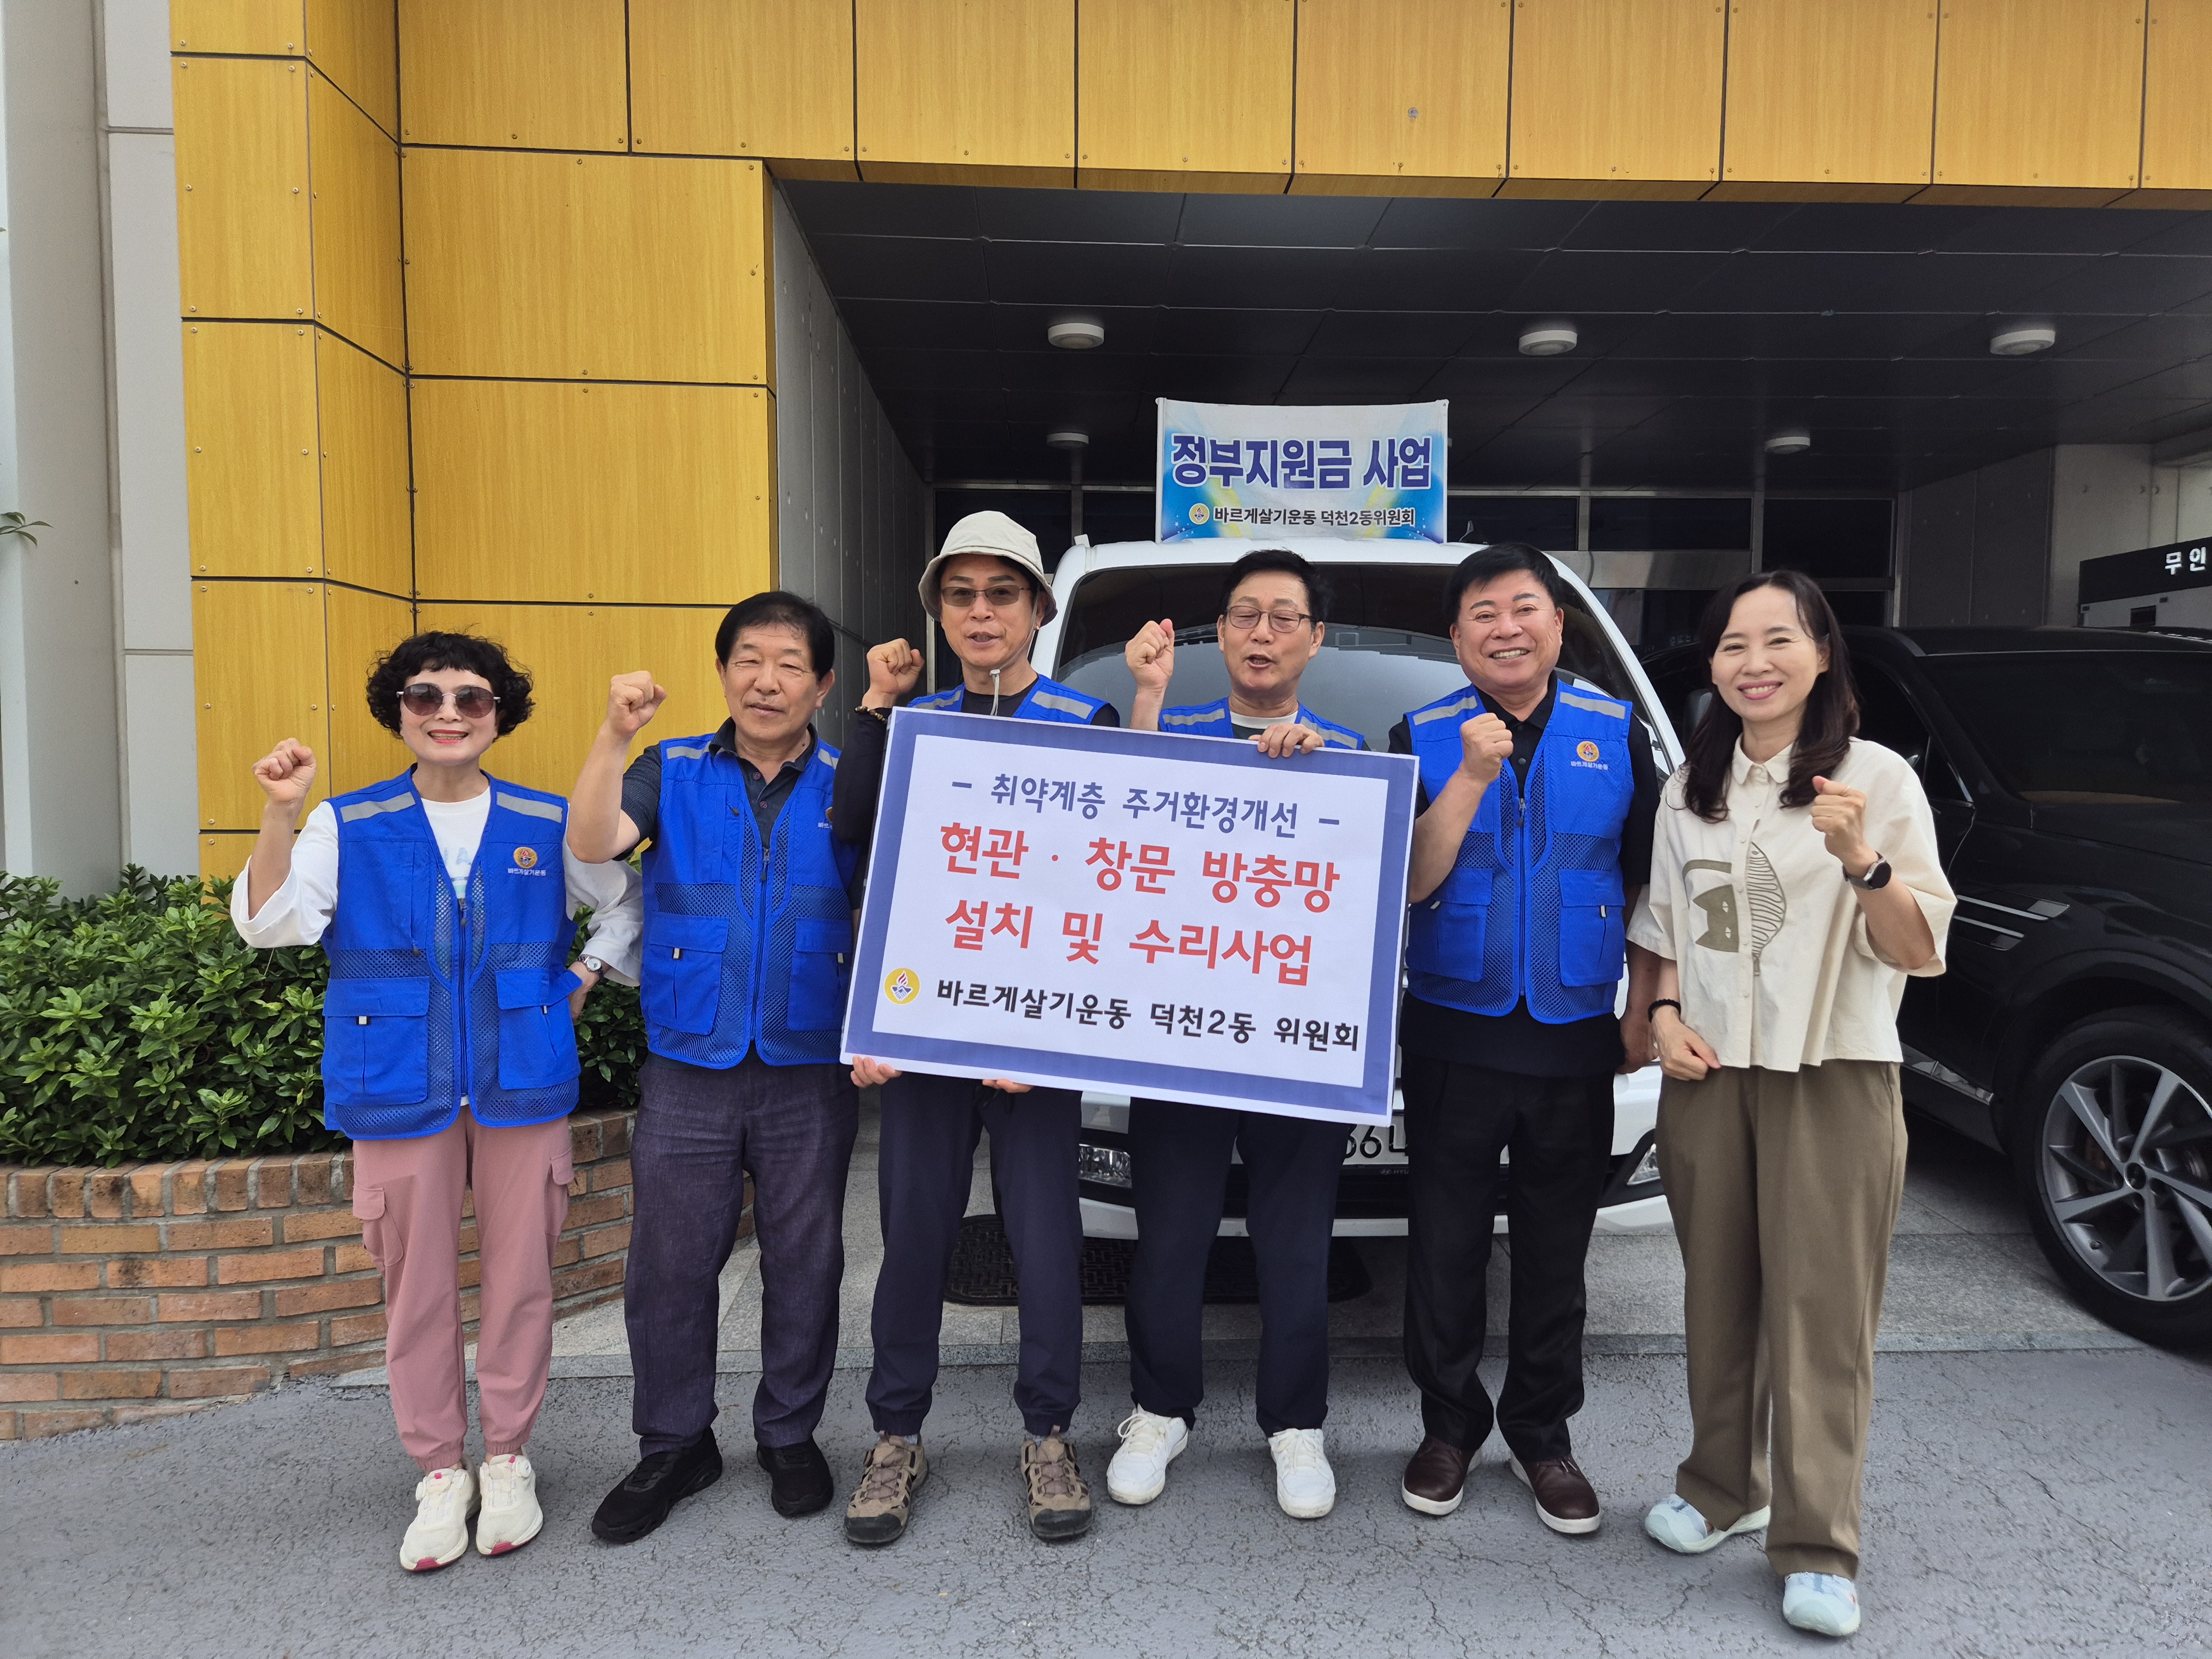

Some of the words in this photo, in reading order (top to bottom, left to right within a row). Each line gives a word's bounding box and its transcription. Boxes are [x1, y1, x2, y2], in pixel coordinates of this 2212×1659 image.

[1172, 434, 1352, 489] 정부지원금
[1363, 437, 1431, 488] 사업
[1214, 507, 1317, 525] 바르게살기운동
[1321, 509, 1415, 526] 덕천2동위원회
[2164, 546, 2207, 575] 무인
[990, 773, 1105, 820] 취약계층
[1122, 788, 1298, 839] 주거환경개선
[940, 822, 1029, 879] 현관
[1085, 837, 1176, 895] 창문
[1202, 851, 1340, 913] 방충망
[945, 899, 1034, 951] 설치
[1062, 912, 1103, 964] 및
[1129, 919, 1313, 987] 수리사업
[937, 979, 1132, 1030] 바르게살기운동
[1150, 1003, 1256, 1044] 덕천2동
[1273, 1016, 1359, 1052] 위원회
